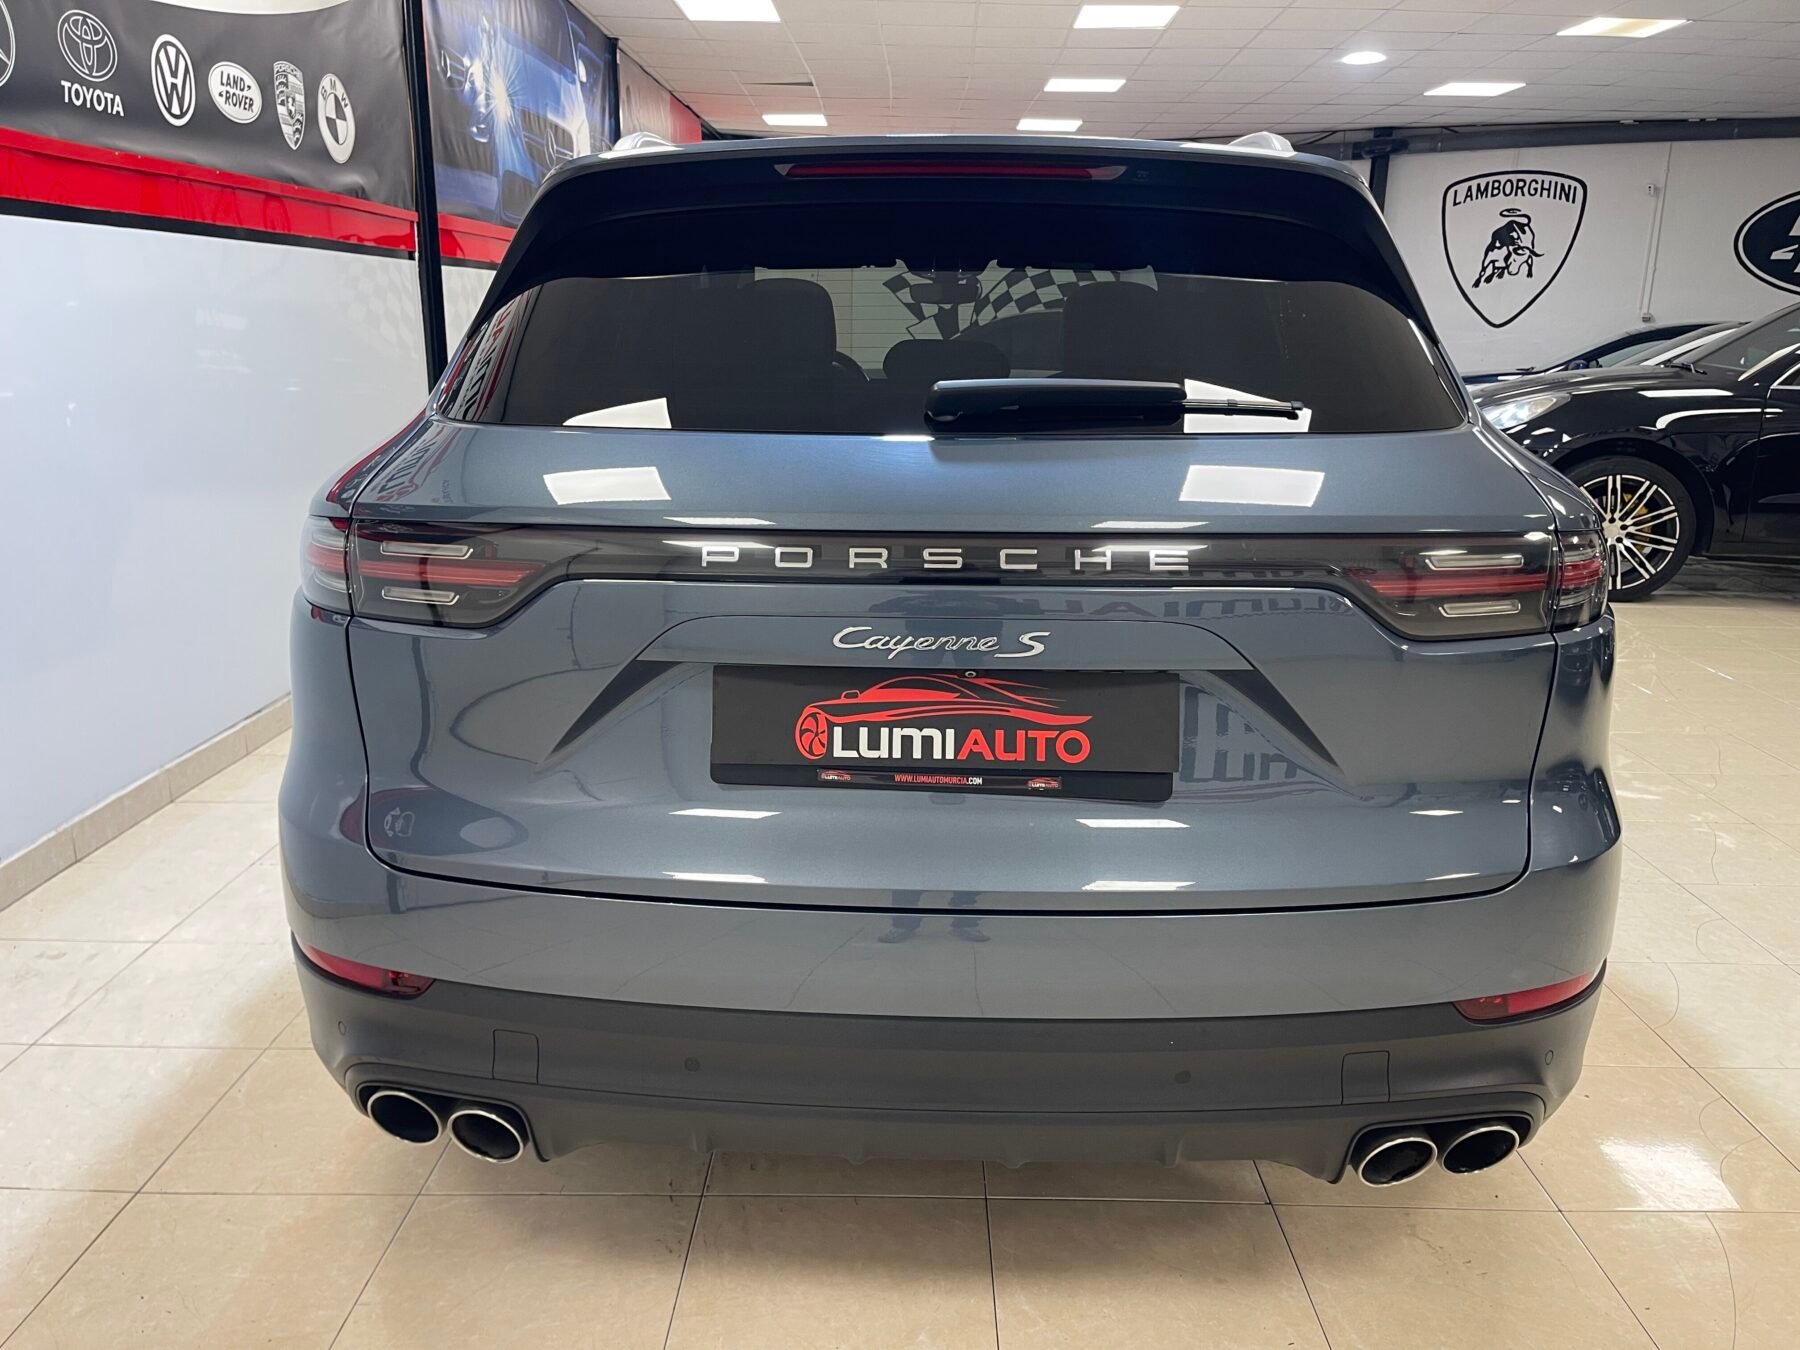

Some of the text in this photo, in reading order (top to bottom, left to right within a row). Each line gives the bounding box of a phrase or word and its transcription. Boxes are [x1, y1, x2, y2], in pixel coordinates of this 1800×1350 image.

[60, 79, 125, 117] TOYOTA
[225, 90, 254, 113] ROVER
[320, 78, 348, 109] BMW
[1452, 178, 1578, 207] LAMBORGHINI
[700, 546, 1190, 570] PORSCHE
[832, 626, 1052, 660] Cayenne S
[832, 726, 1092, 764] LUMIAUTO
[894, 774, 983, 785] WWW.LUMIAUTOMURCIA.COM
